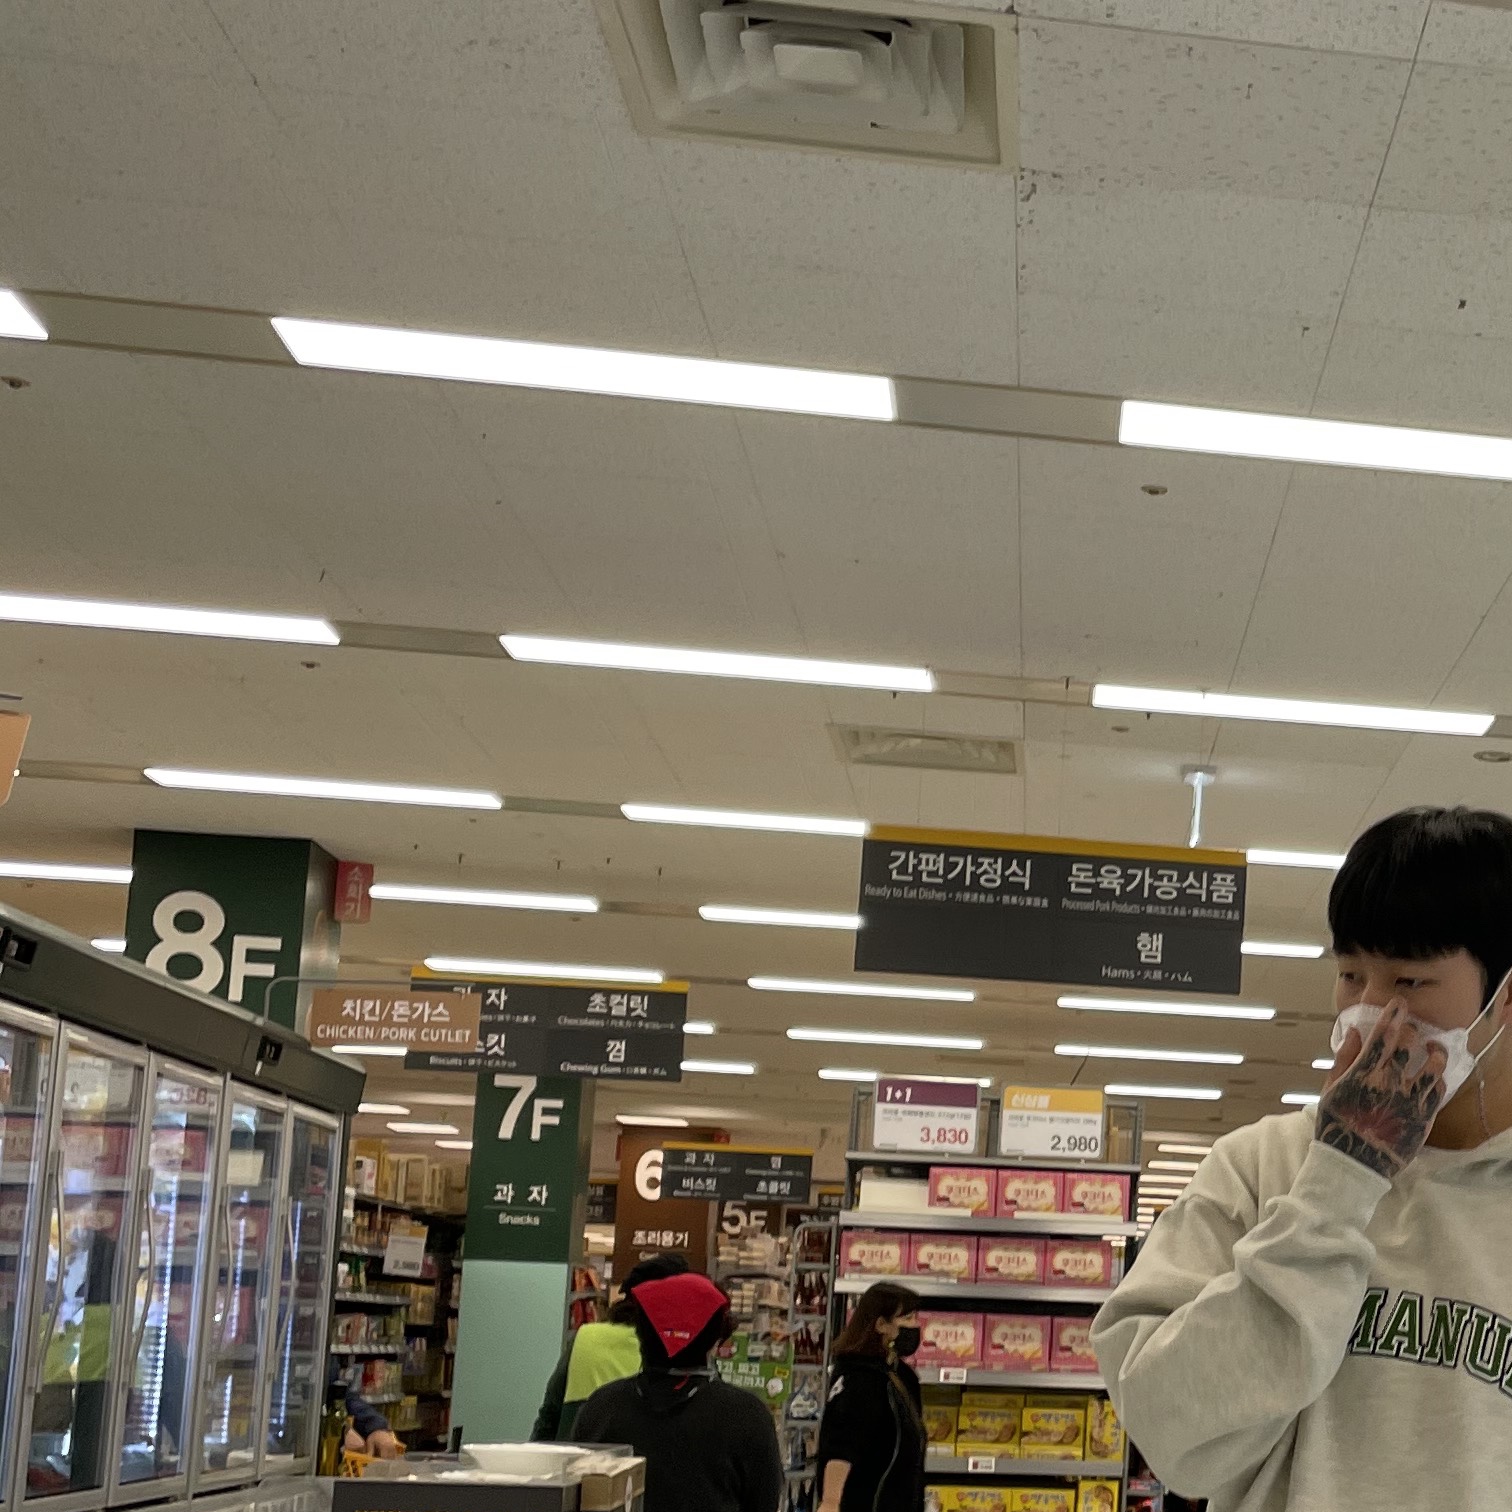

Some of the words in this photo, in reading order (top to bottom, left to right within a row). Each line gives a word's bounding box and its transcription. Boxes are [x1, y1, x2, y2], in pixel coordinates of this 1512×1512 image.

[888, 850, 1032, 891] 간편가정식
[865, 883, 891, 899] Ready
[893, 887, 903, 899] to
[904, 887, 917, 899] Eat
[919, 887, 946, 902] Dishes
[1067, 862, 1237, 904] 돈육가공식품
[145, 889, 283, 1003] 8F
[1136, 931, 1164, 965] 햄
[1102, 965, 1135, 980] Hams
[341, 998, 450, 1023] 치킨/돈가스
[316, 1024, 416, 1043] CHICKEN/PORK
[421, 1027, 471, 1043] CUTLET
[606, 1039, 627, 1063] 껌
[493, 1073, 564, 1142] 7F
[920, 1127, 968, 1144] 3,830
[1050, 1134, 1098, 1152] 2,980
[494, 1183, 515, 1204] 과
[527, 1184, 548, 1206] 자
